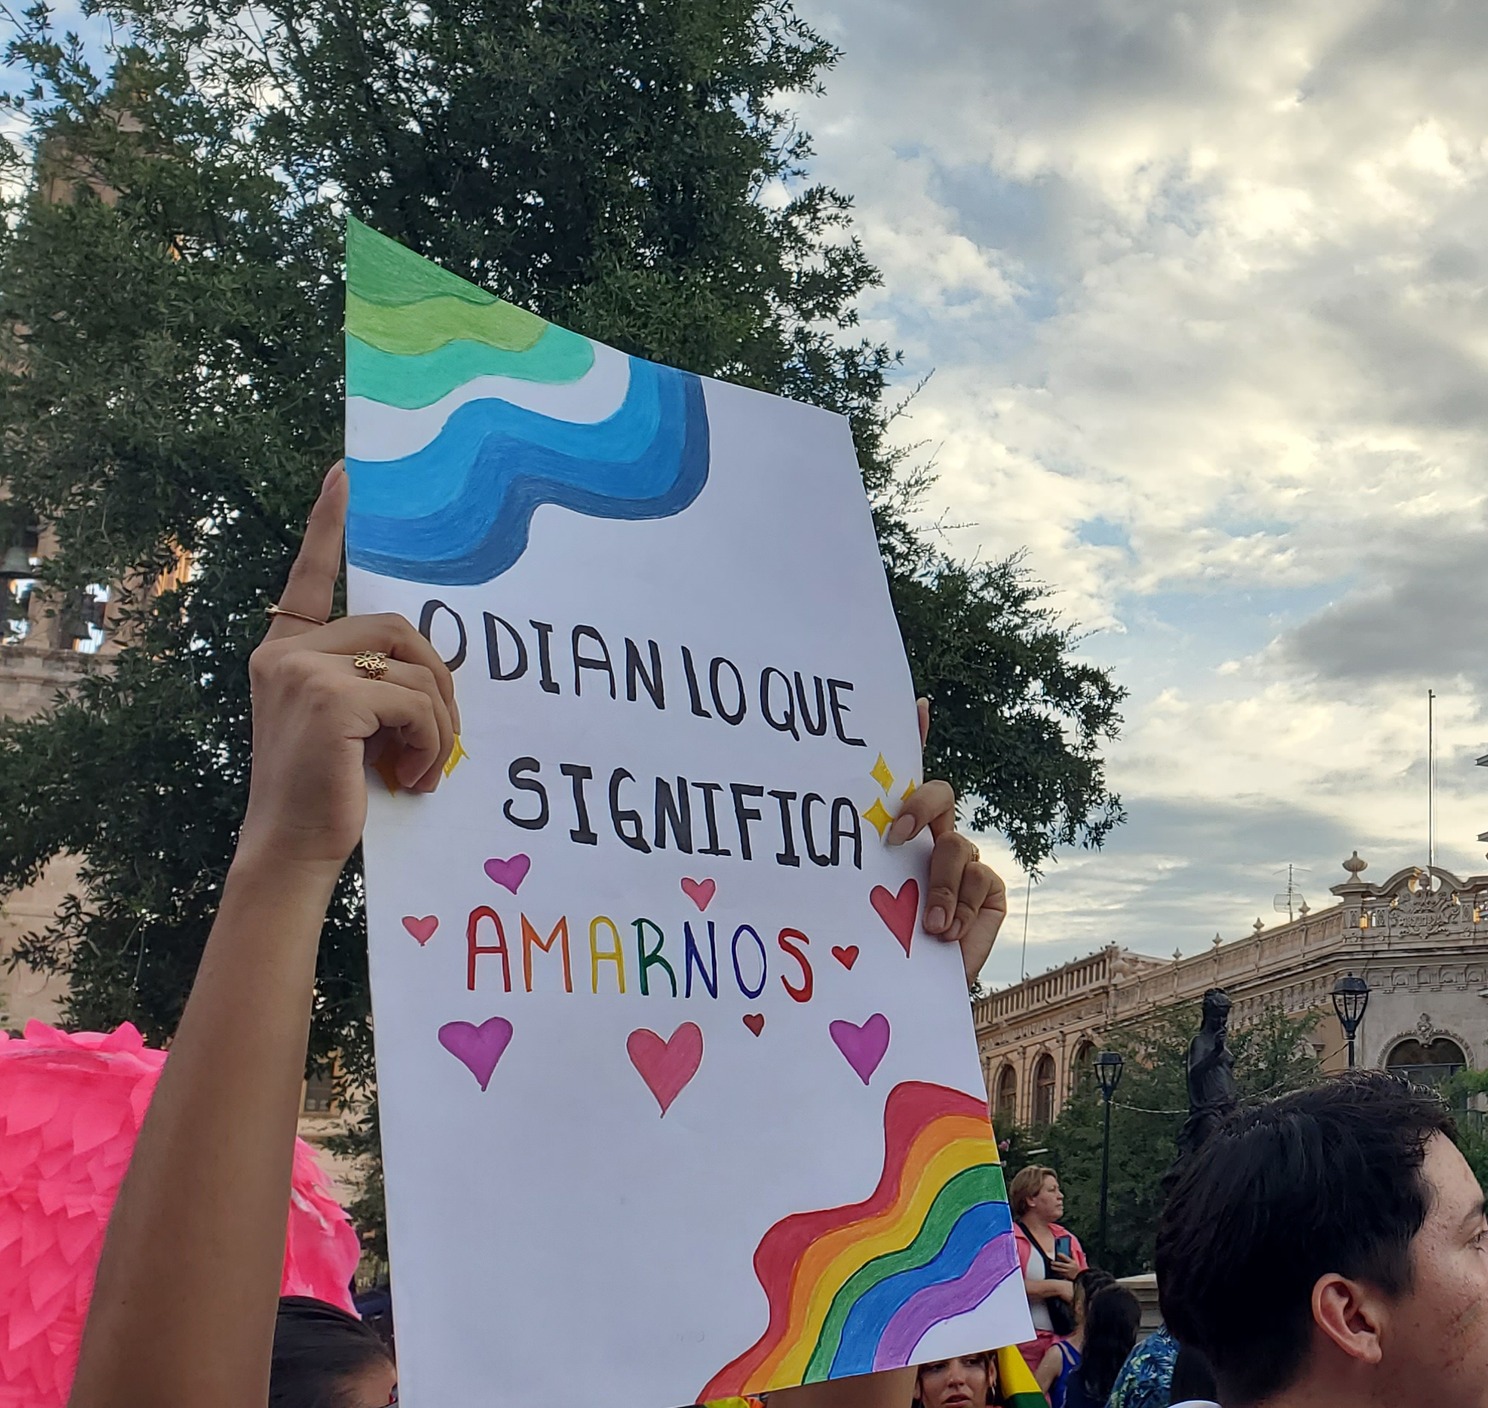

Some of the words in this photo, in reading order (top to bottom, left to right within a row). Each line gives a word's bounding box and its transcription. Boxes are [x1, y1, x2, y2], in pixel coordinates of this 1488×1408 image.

[418, 599, 664, 709] ODIAN
[680, 645, 747, 726] LO
[760, 666, 867, 747] QUE
[503, 756, 862, 870] SIGNIFICA
[467, 906, 814, 1003] AMARNOS
